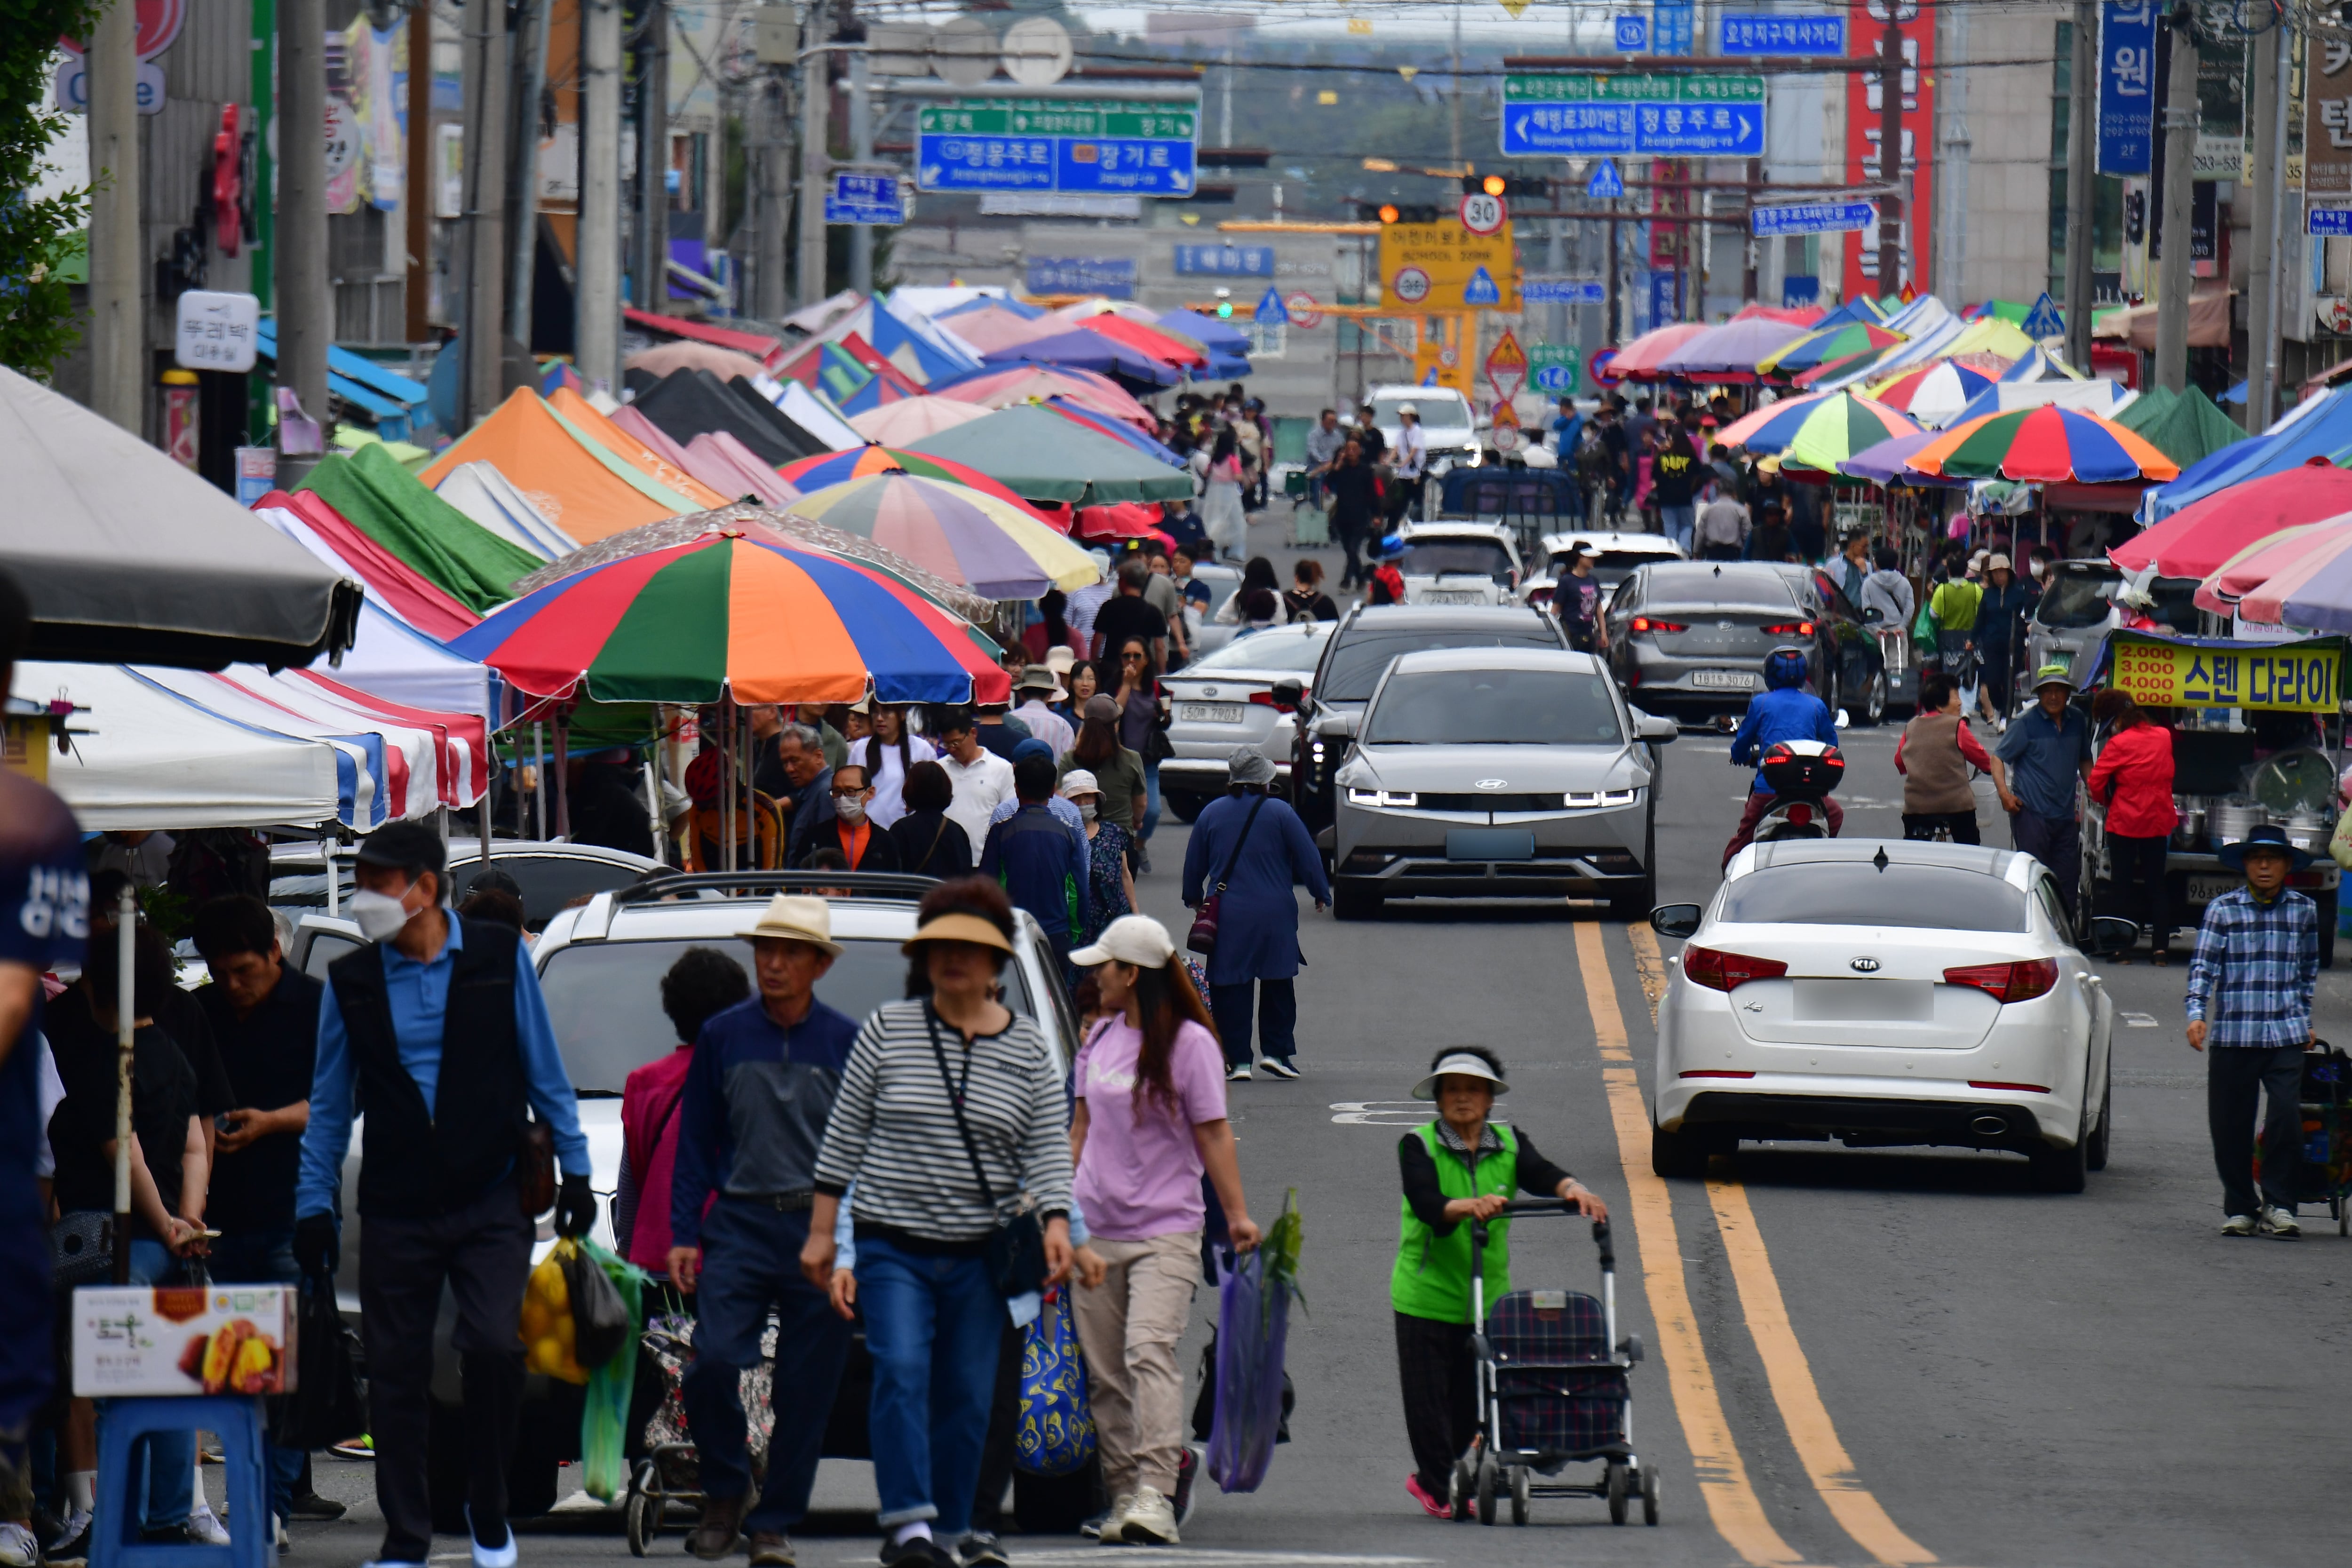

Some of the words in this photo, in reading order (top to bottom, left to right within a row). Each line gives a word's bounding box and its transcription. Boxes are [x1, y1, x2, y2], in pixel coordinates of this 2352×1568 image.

[1725, 23, 1839, 47] 오천지구대사거리
[1641, 108, 1732, 134] 정몽주로
[966, 142, 1049, 167] 정몽주로
[1100, 143, 1170, 170] 장기로
[2121, 144, 2137, 156] 2F
[1470, 201, 1494, 223] 30
[2313, 211, 2347, 224] 세계길
[1543, 370, 1565, 385] 14
[2249, 656, 2332, 705] 다라이
[1855, 960, 1876, 969] KIA
[1744, 1001, 1763, 1011] K5
